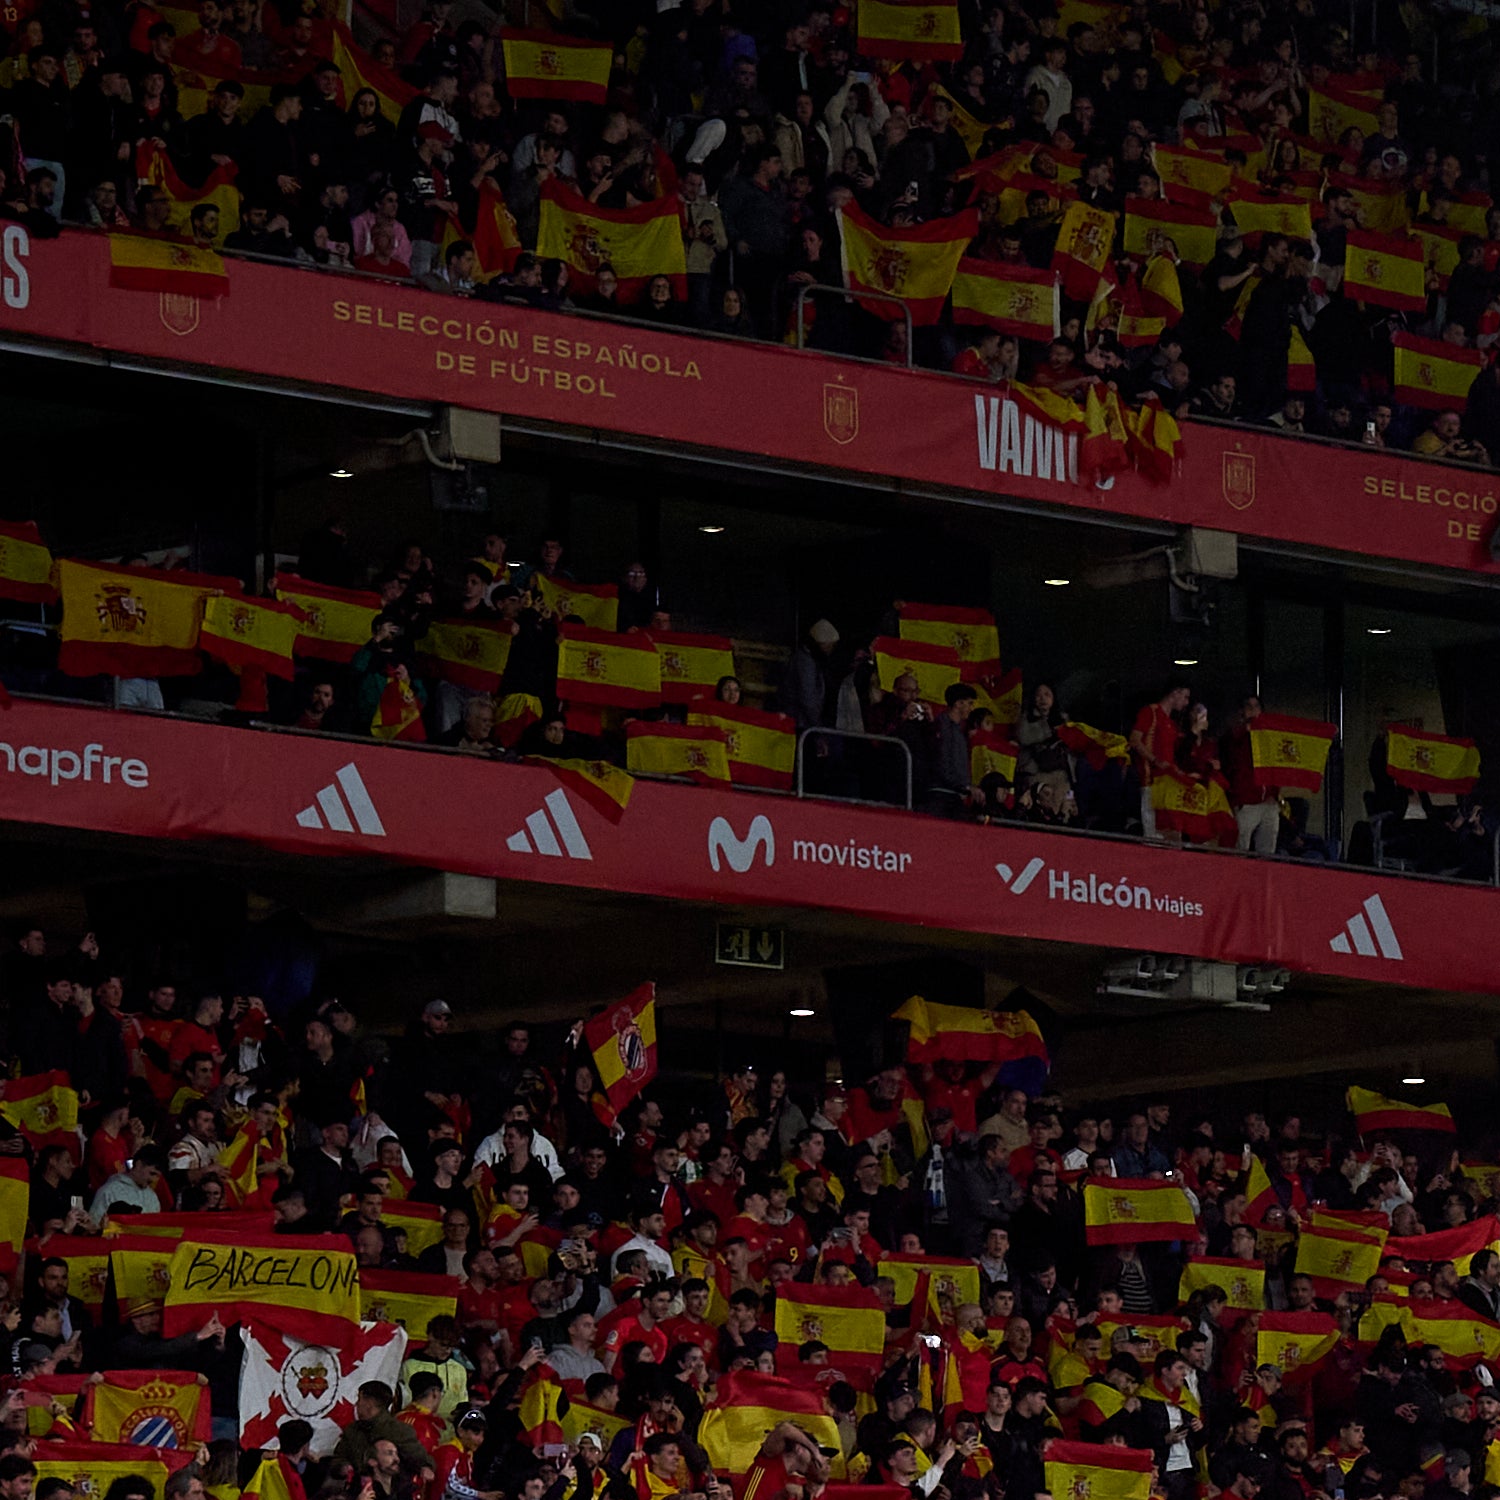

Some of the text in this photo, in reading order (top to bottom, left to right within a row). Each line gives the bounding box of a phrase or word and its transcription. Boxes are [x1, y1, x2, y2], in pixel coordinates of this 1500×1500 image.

[332, 299, 703, 382] SELECCIÓN ESPAÑOLA
[436, 350, 617, 399] DE FÚTBOL
[974, 394, 1116, 491] VAM
[1363, 475, 1499, 514] SELECCIÓ
[1446, 519, 1481, 542] DE
[793, 835, 912, 876] movistar
[1047, 867, 1204, 918] Halcón viajes
